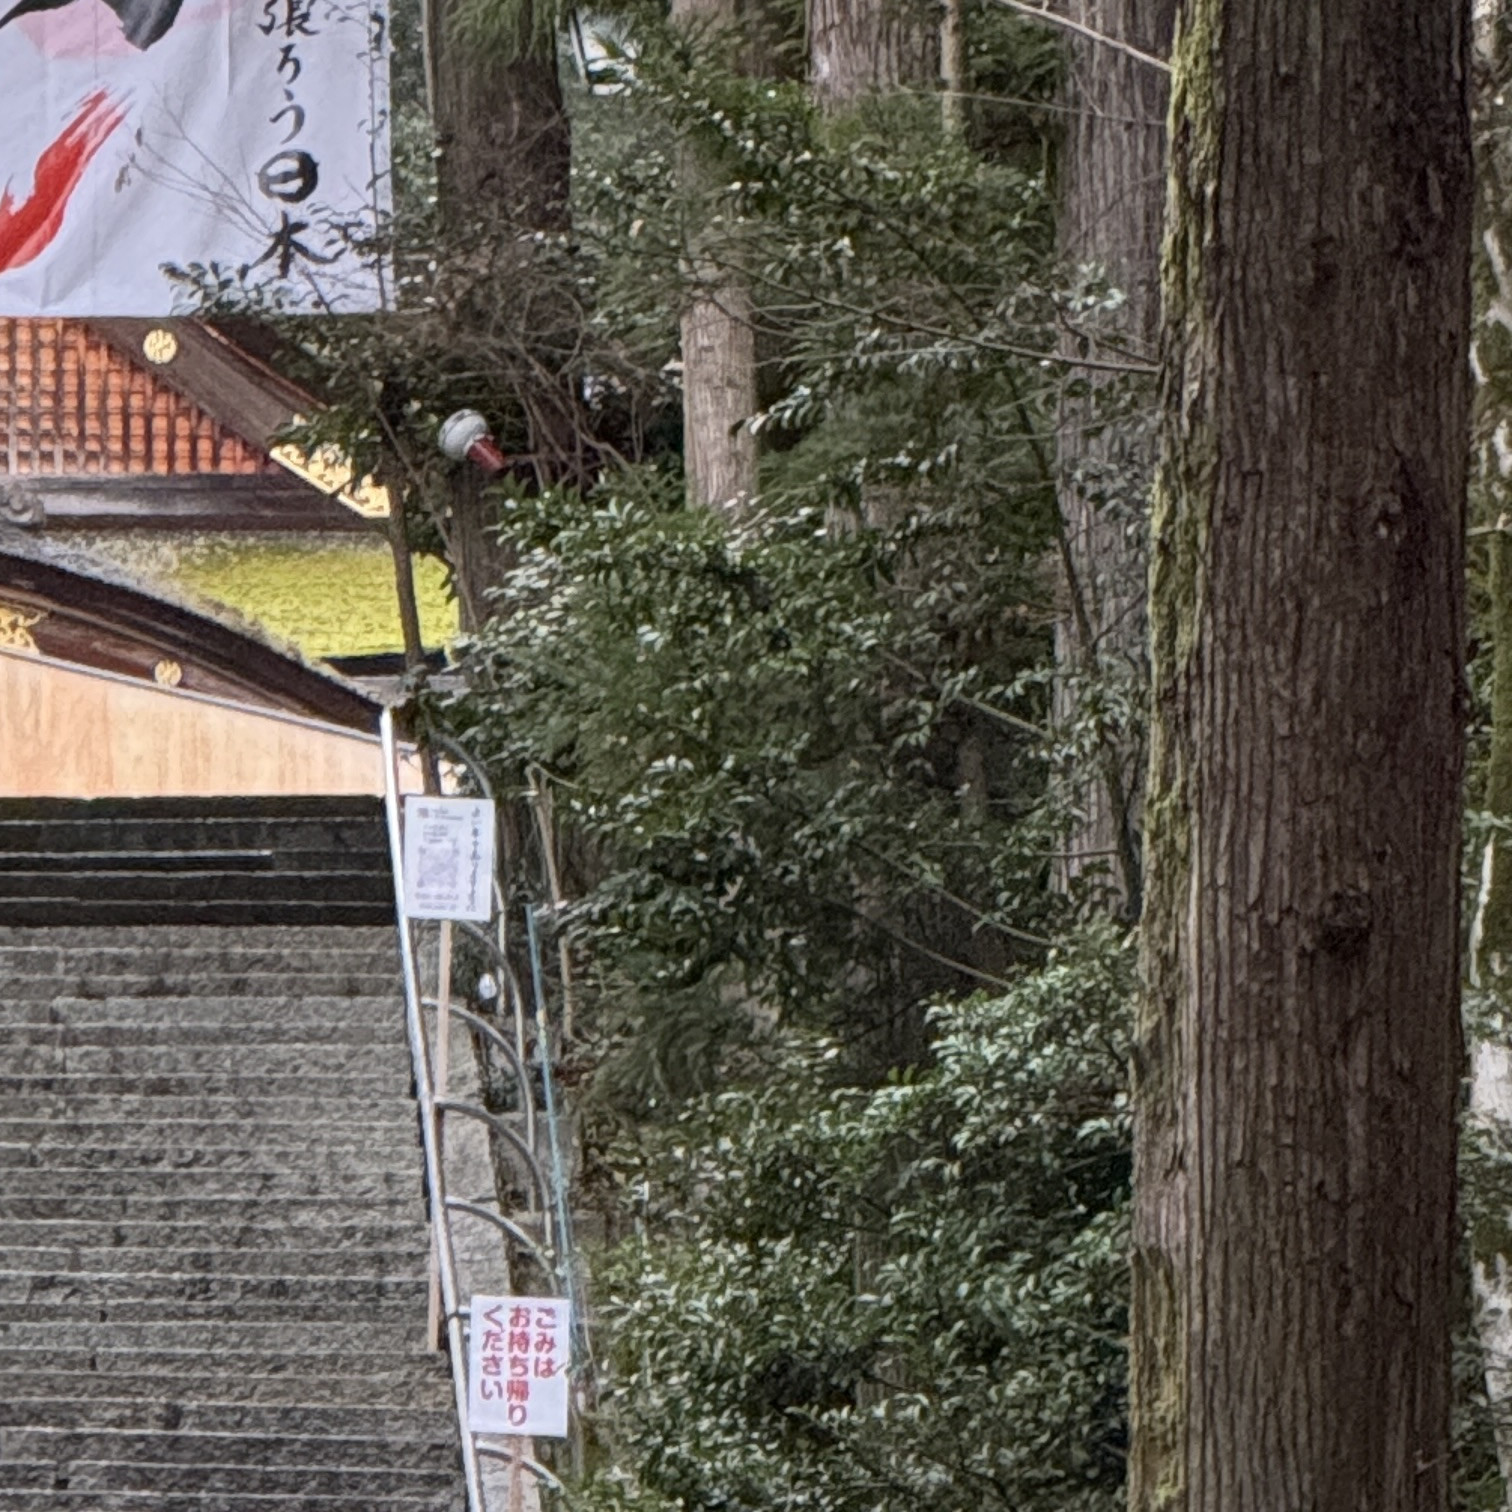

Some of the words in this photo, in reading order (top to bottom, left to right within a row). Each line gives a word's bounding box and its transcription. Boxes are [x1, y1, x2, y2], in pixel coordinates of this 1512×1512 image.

[506, 1305, 531, 1426] お持ち帰り
